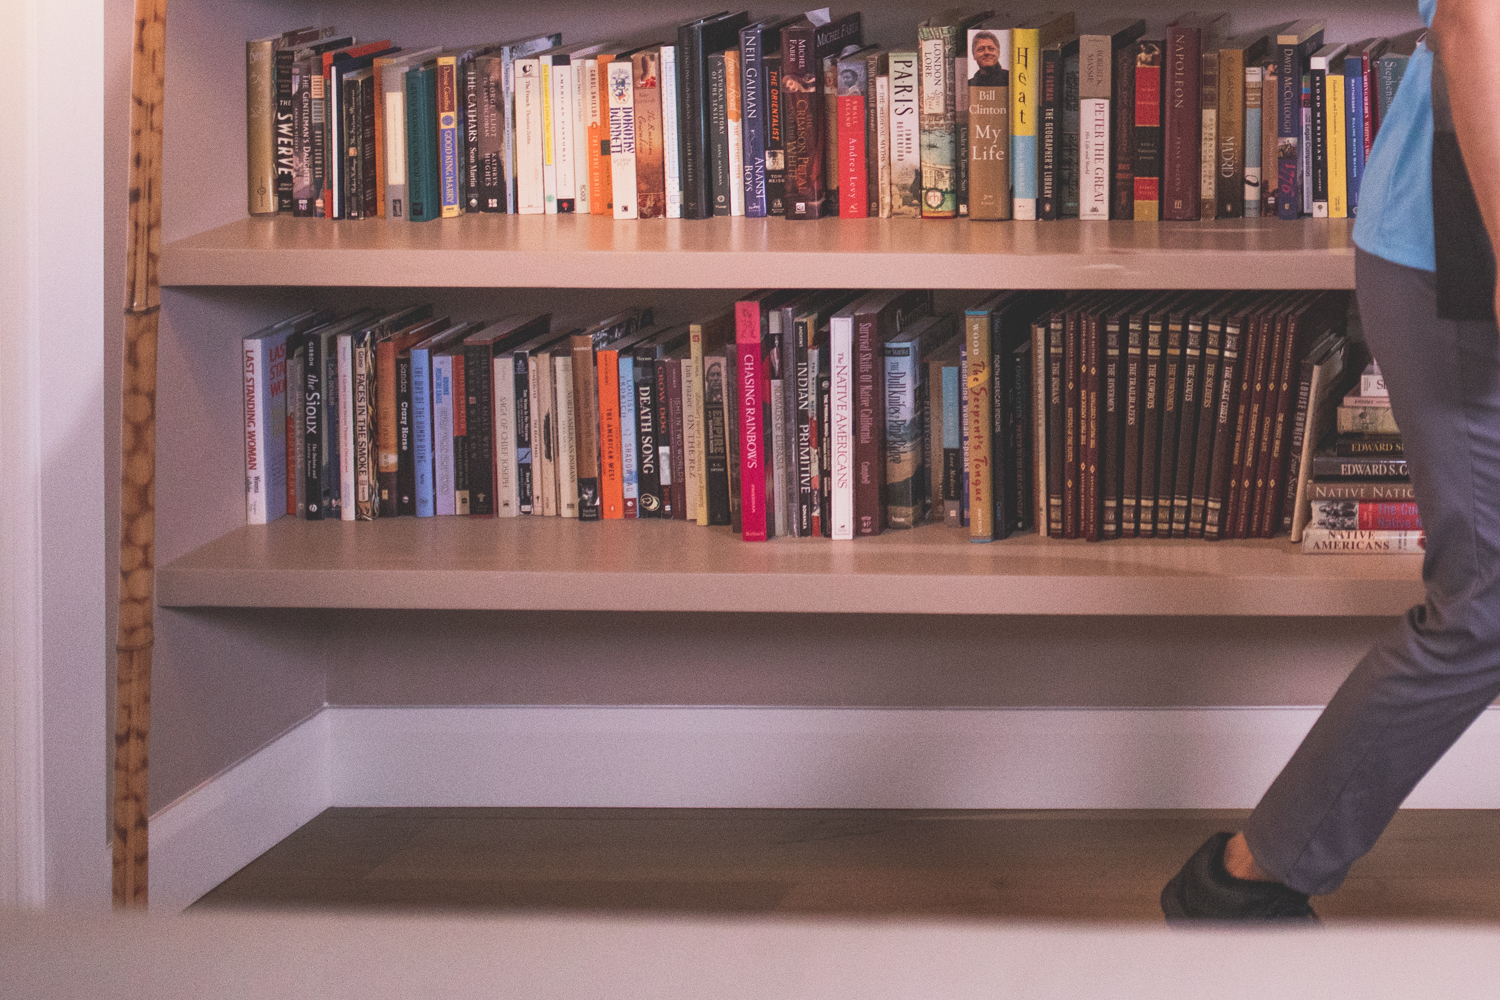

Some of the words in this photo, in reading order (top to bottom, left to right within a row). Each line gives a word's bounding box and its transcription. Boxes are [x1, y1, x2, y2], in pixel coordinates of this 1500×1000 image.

[746, 36, 756, 64] NEIL
[746, 68, 757, 118] GAIMAN
[1045, 108, 1053, 120] THE
[1095, 103, 1104, 139] PETER
[277, 112, 293, 175] SWERVE
[848, 138, 857, 172] Andrea
[1045, 123, 1053, 169] GEOGRAPHER'S
[1095, 143, 1104, 163] THE
[847, 176, 857, 199] Levy
[1044, 172, 1052, 198] LIBRARY
[1094, 167, 1104, 204] GREAT
[245, 350, 255, 374] LAST
[357, 374, 365, 402] FACES
[744, 354, 756, 406] CHASING
[798, 362, 808, 410] INDIAN
[246, 378, 256, 427] STANDING
[357, 405, 365, 415] IN
[358, 418, 366, 437] THE
[745, 408, 757, 468] RAINBOWS
[247, 430, 257, 470] WOMAN
[358, 441, 366, 476] SMOKE
[800, 424, 810, 493] PRIMITIVE
